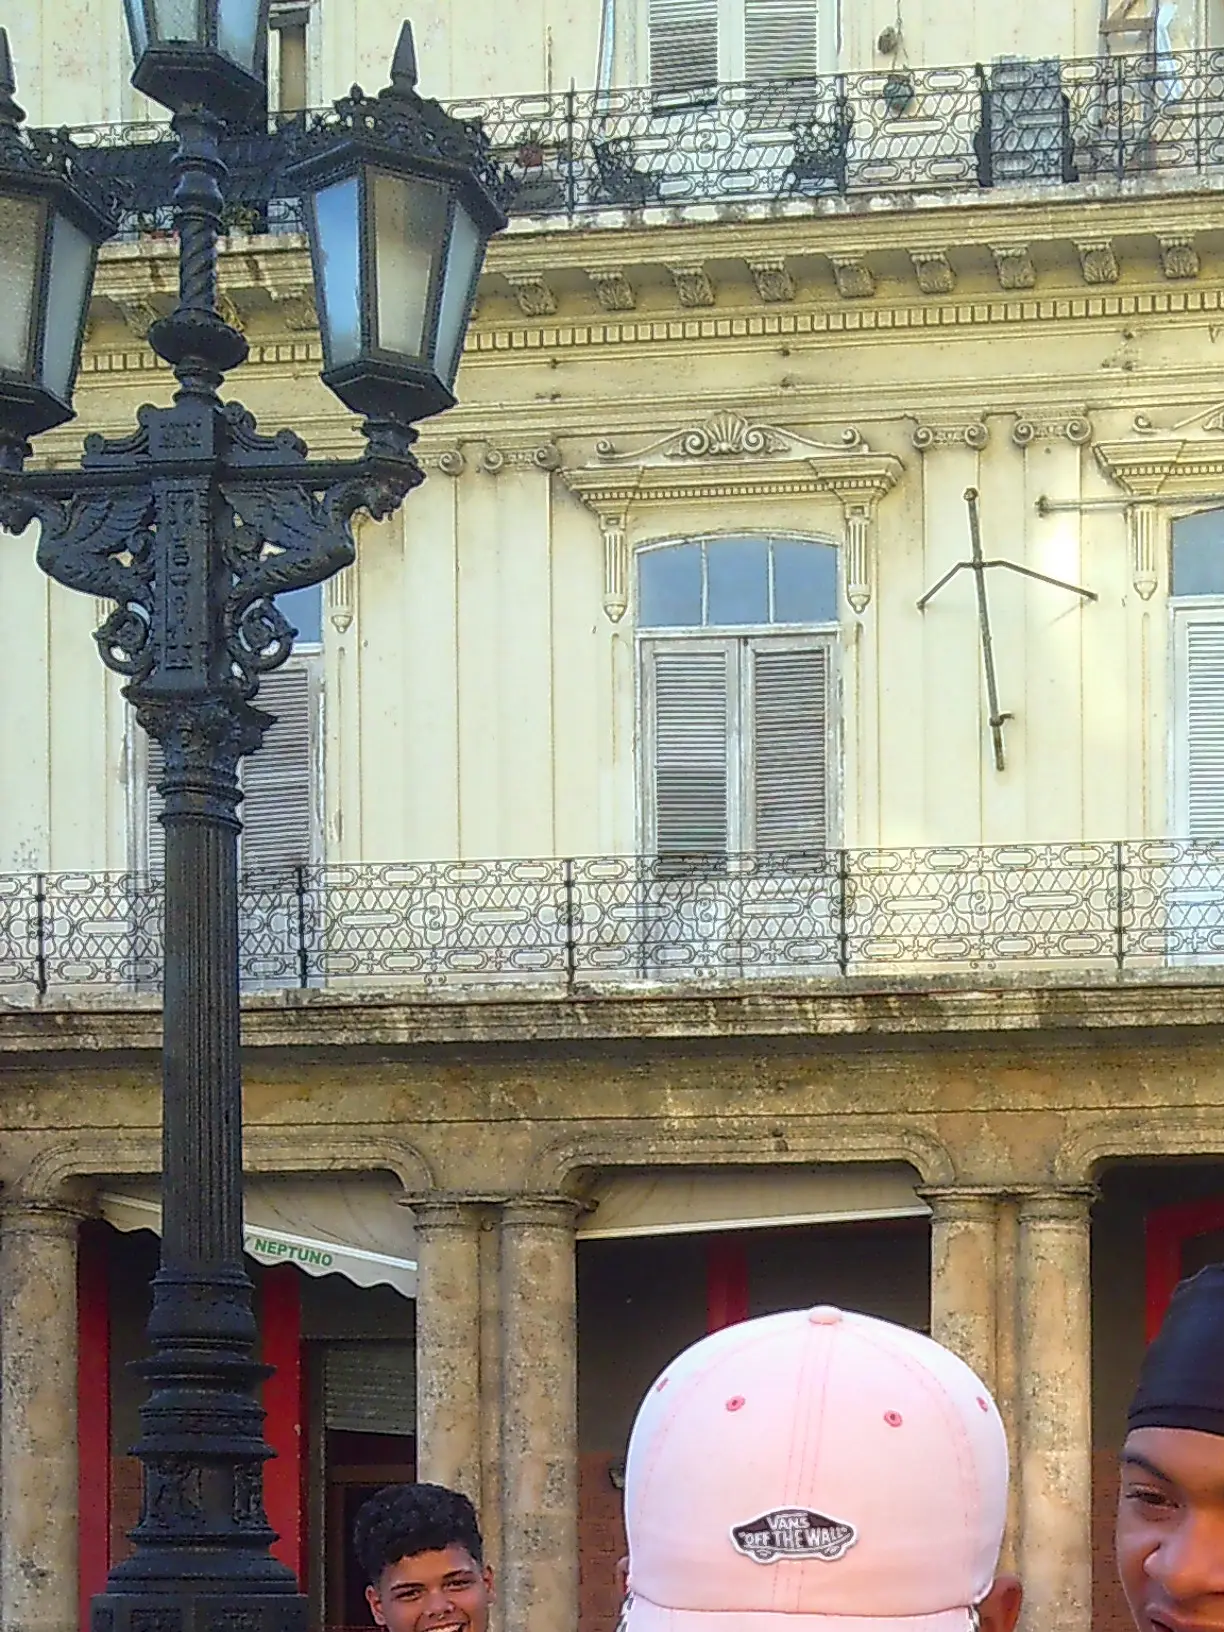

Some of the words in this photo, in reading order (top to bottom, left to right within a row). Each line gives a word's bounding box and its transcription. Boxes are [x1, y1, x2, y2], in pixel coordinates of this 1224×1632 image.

[254, 1238, 333, 1267] NEPTUNO
[766, 1513, 811, 1530] VANS
[772, 1529, 804, 1548] THE
